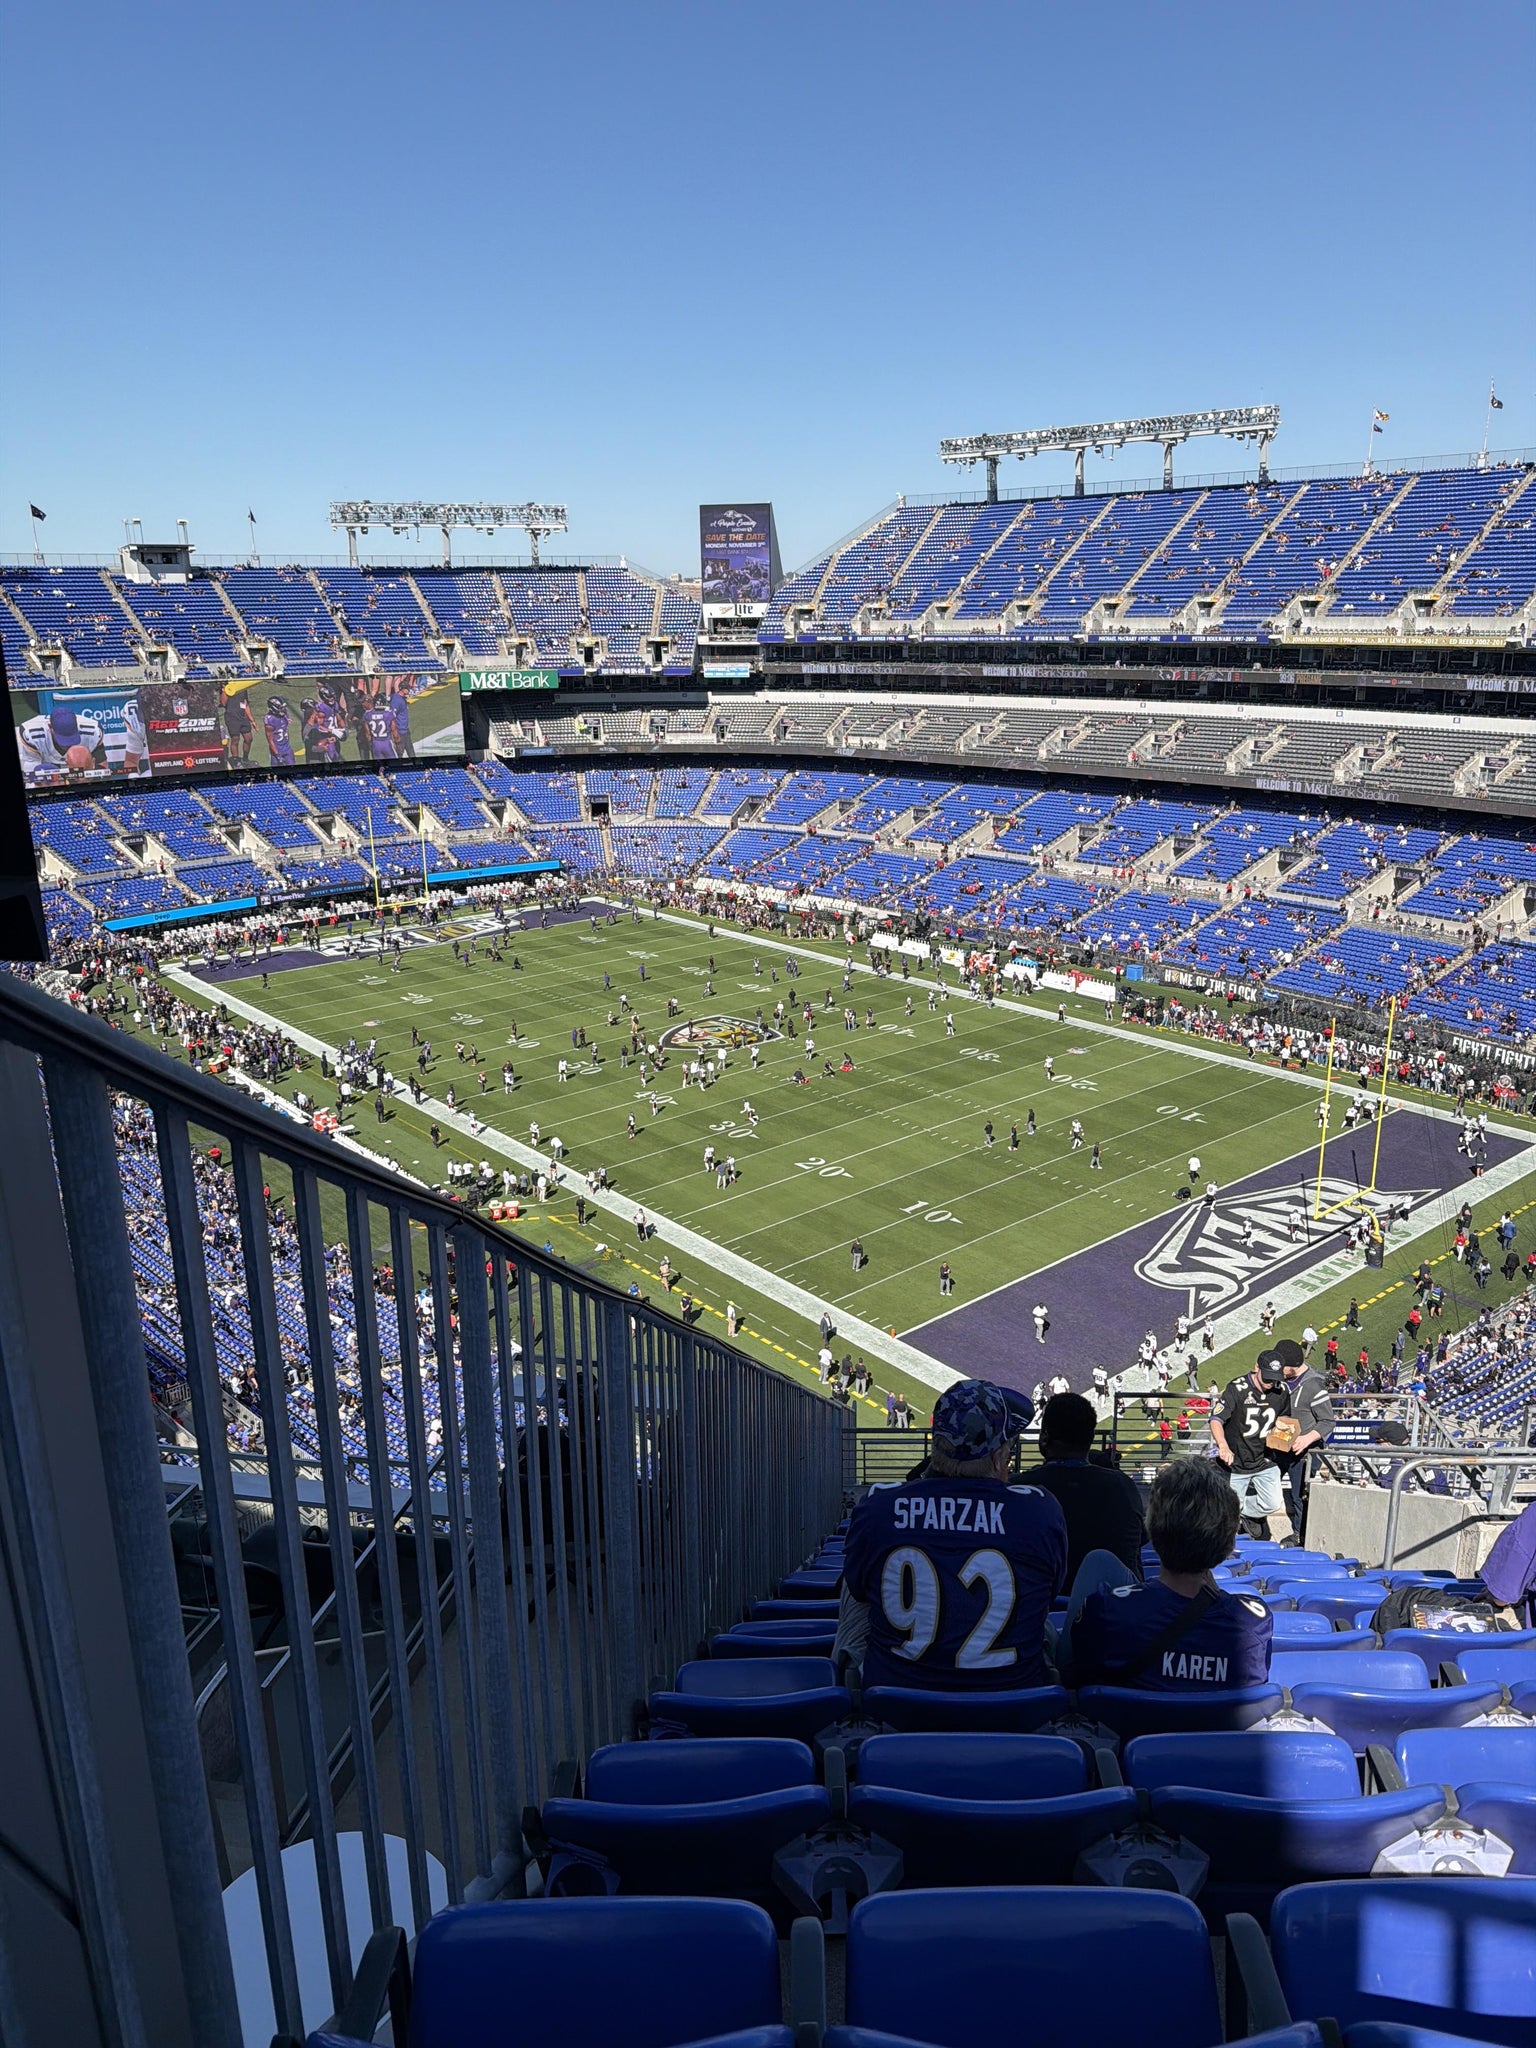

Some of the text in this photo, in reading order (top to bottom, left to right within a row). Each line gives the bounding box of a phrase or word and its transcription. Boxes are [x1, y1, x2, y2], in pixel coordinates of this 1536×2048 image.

[706, 533, 766, 542] SAVE THE DATE
[734, 604, 753, 617] Lite
[802, 664, 829, 674] WELCOME
[875, 666, 902, 675] Stadium
[983, 667, 1010, 676] WELCOME
[1056, 669, 1087, 678] Stadium
[469, 672, 550, 689] M&T Bank
[1466, 678, 1506, 692] WELCOME
[1508, 680, 1518, 692] TO
[368, 720, 388, 738] 22
[1256, 778, 1400, 801] WELCOME TO M&T Bank Stadium
[1196, 976, 1206, 986] OF
[1210, 979, 1226, 994] THE
[1228, 982, 1258, 1002] FLOCK
[959, 1047, 1000, 1062] 30
[1452, 1036, 1536, 1072] FIGHT! FIGHT!
[1051, 1074, 1098, 1092] 20
[1156, 1106, 1206, 1122] 10
[708, 1120, 753, 1138] 30
[794, 1157, 845, 1177] 20
[899, 1200, 952, 1223] 10
[1134, 1177, 1442, 1322] RAVENS
[1291, 1258, 1359, 1293] HATE
[1242, 1407, 1276, 1438] 52
[894, 1497, 1006, 1535] SPARZAK
[880, 1545, 1018, 1669] 92
[1414, 1609, 1428, 1630] DAY
[1162, 1650, 1229, 1682] KAREN
